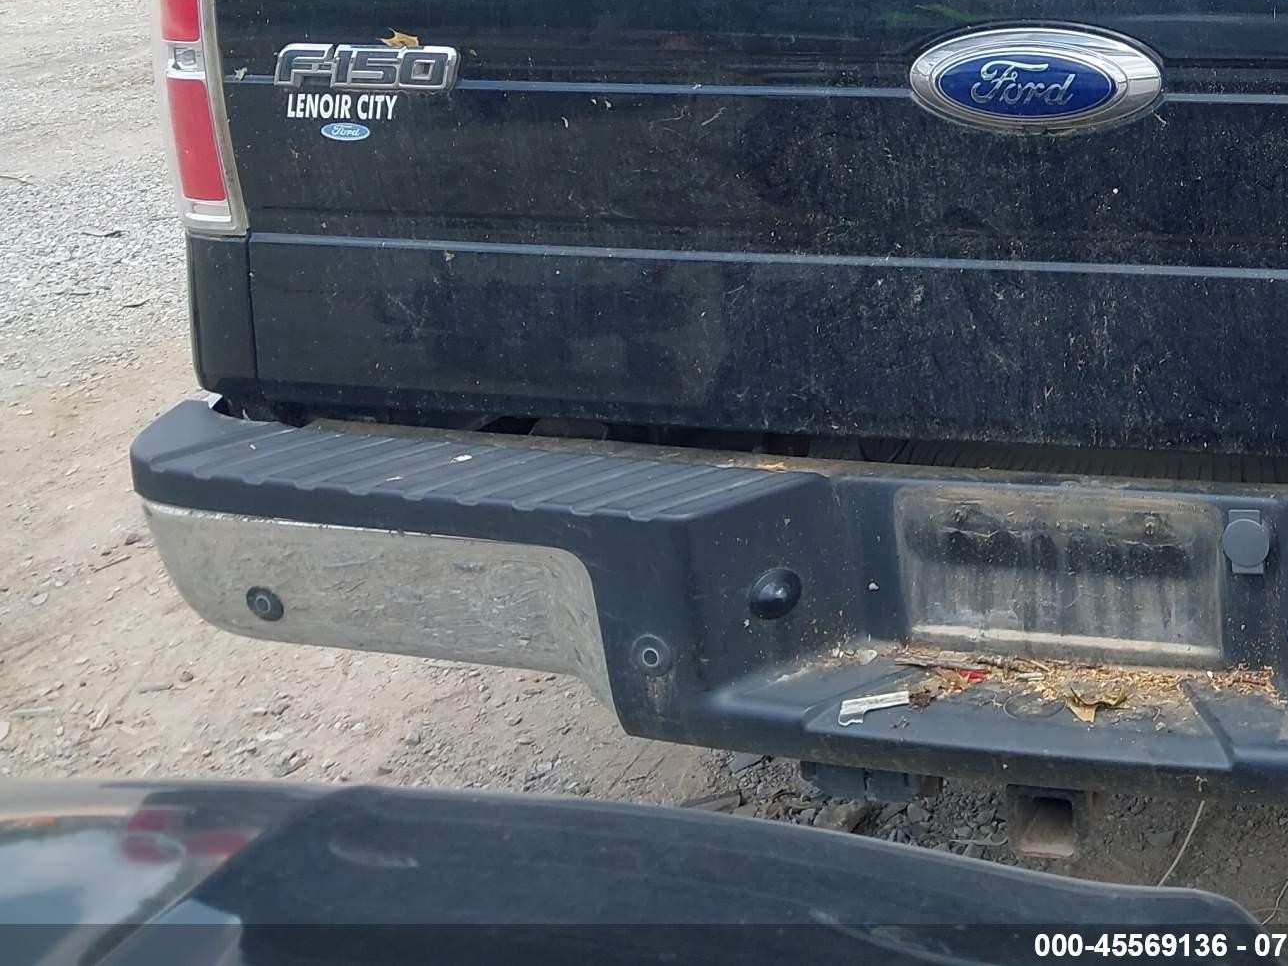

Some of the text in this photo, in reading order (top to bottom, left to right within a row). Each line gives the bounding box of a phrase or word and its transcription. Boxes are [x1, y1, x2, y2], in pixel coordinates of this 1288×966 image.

[274, 43, 459, 91] F-150
[970, 59, 1076, 105] Ford
[287, 93, 398, 120] LENOIR CITY
